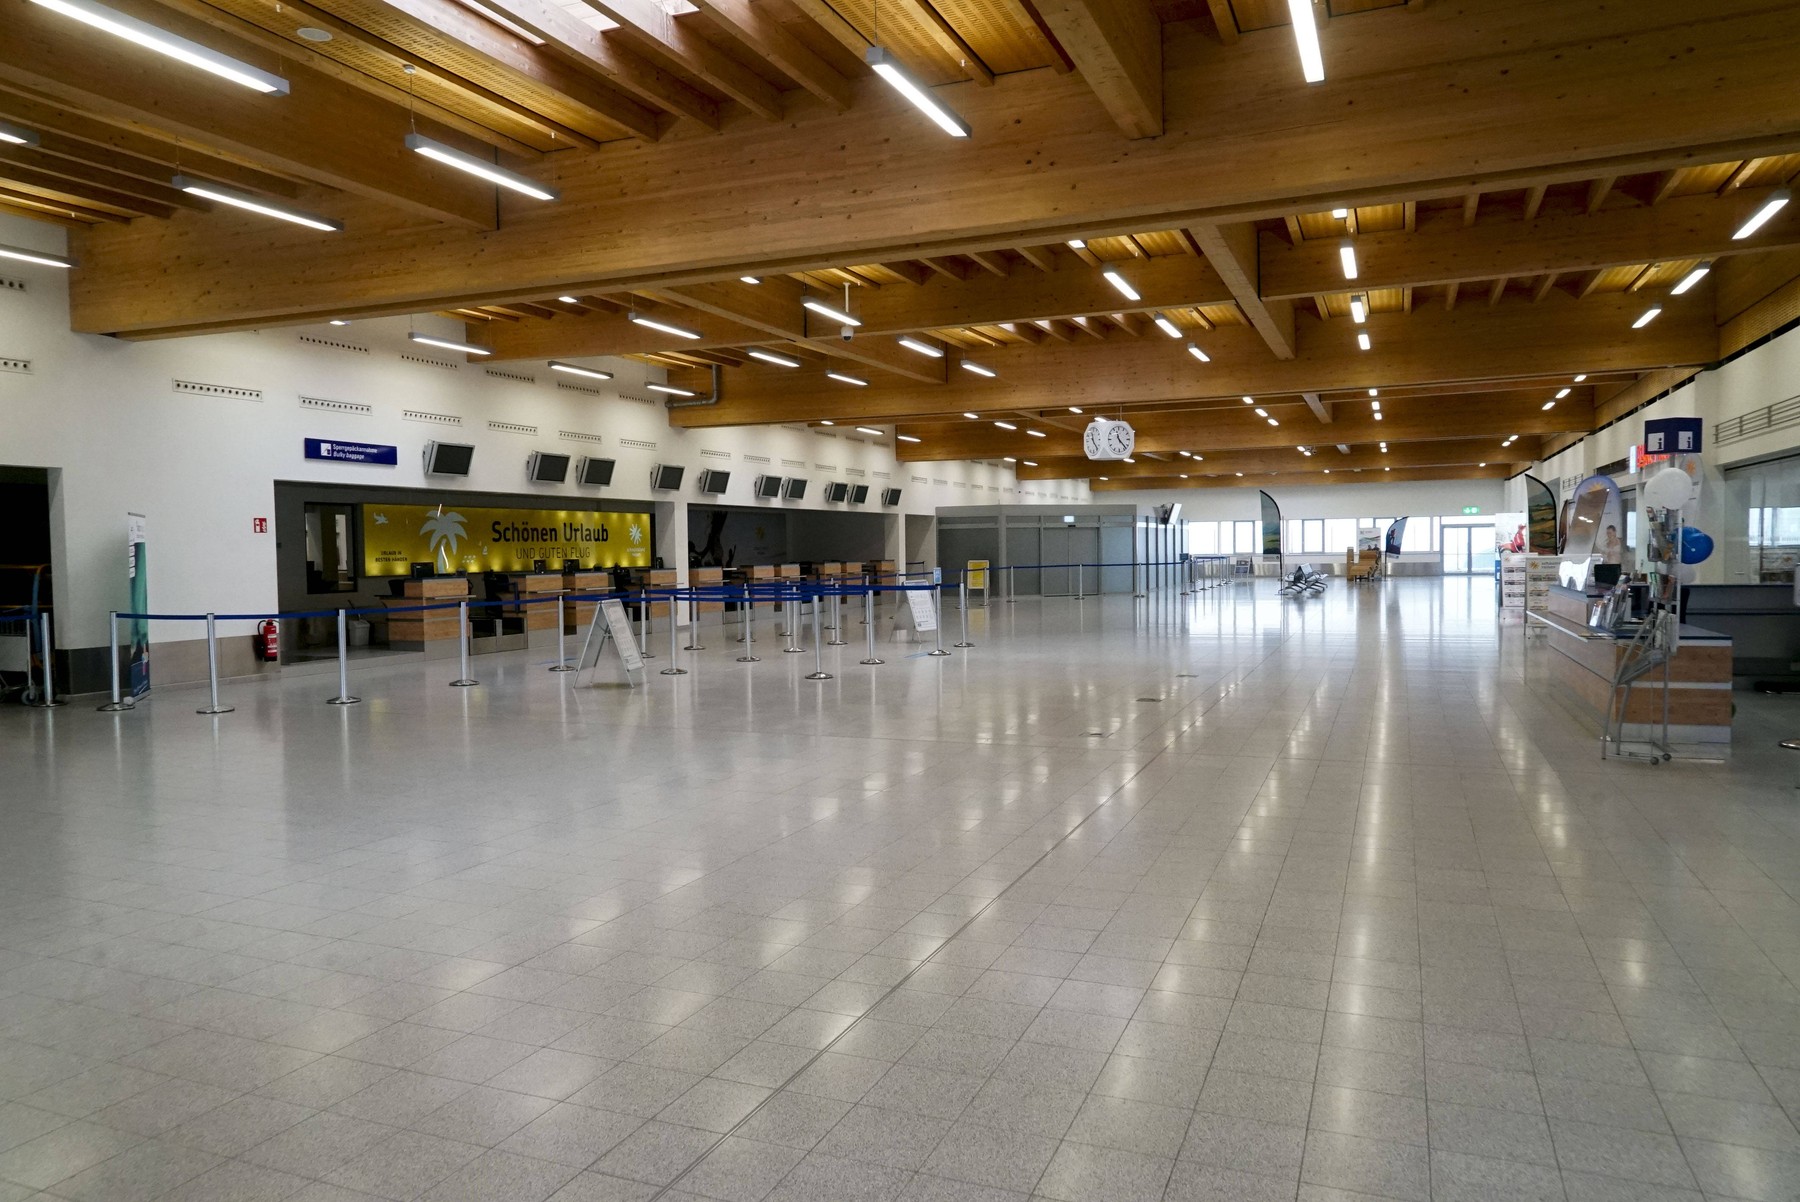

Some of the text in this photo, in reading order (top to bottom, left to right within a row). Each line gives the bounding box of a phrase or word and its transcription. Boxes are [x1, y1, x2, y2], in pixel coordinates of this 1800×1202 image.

[333, 451, 365, 460] Bulky baggage
[492, 520, 609, 543] Schönen Urlaub
[516, 546, 590, 560] UND GUTEN FLUG
